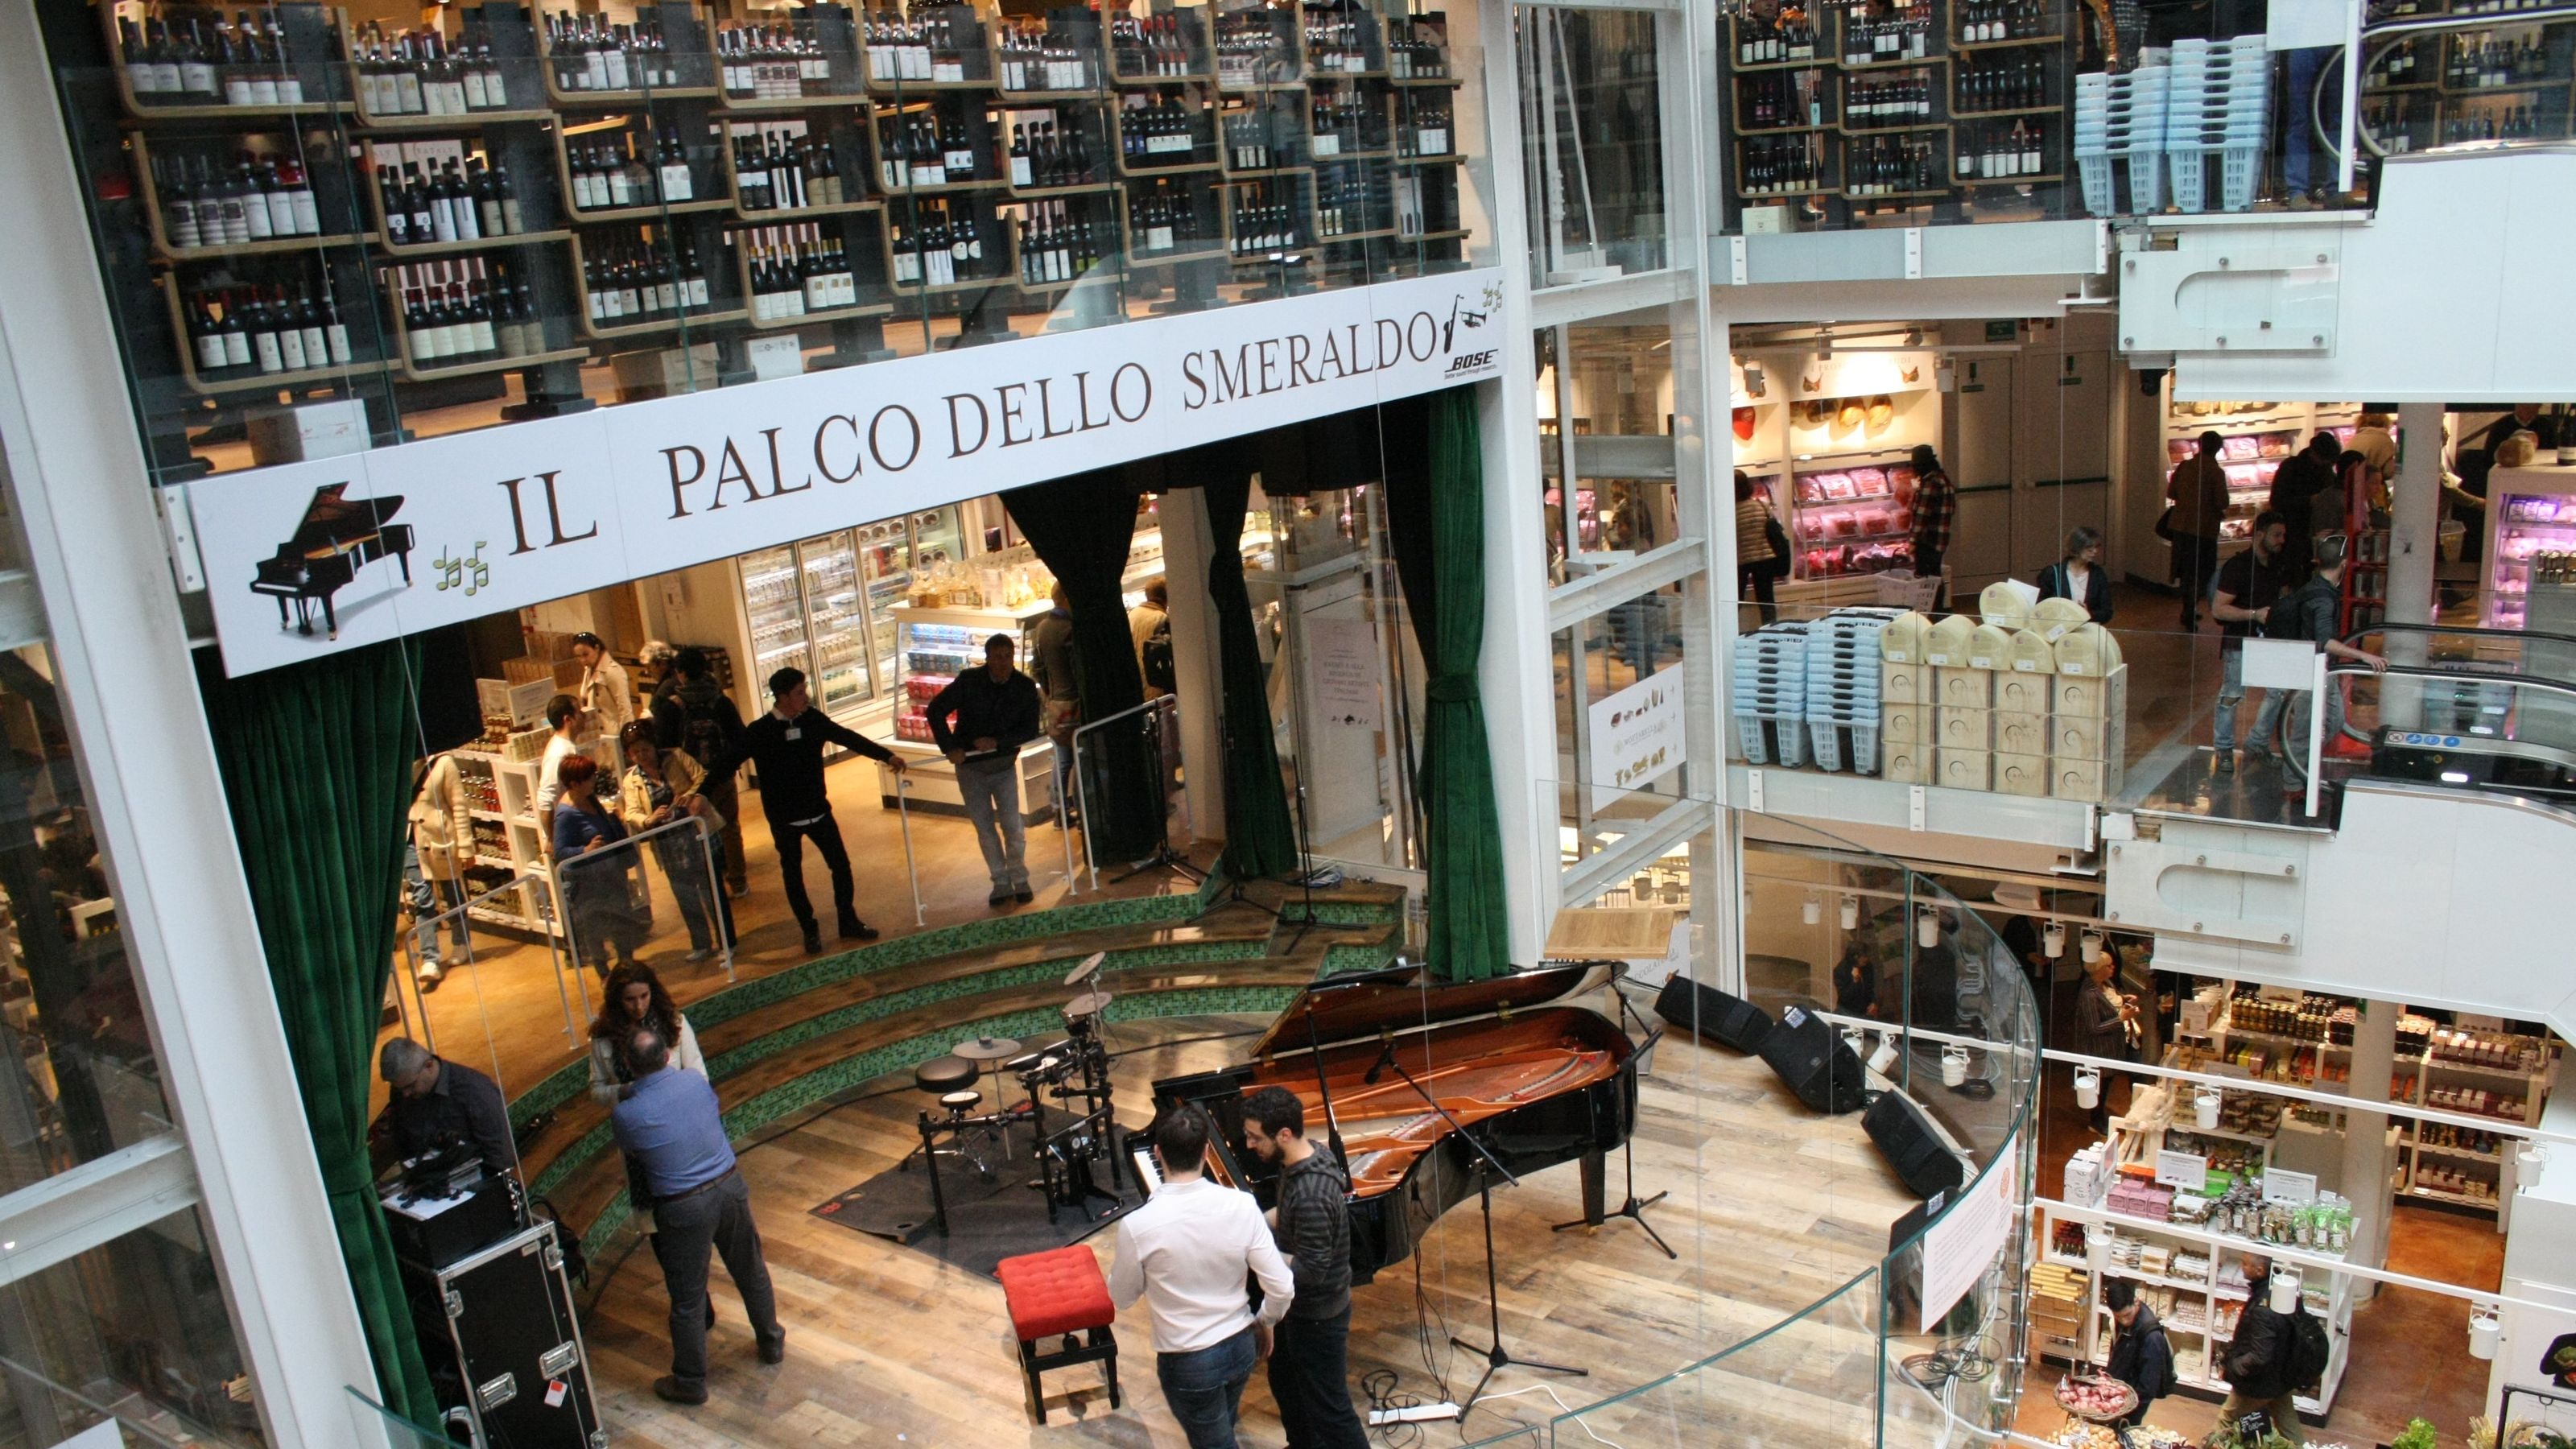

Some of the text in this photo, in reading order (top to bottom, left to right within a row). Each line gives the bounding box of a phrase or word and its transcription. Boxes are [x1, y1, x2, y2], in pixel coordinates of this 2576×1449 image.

[1444, 349, 1499, 373] BOSE
[497, 311, 1437, 555] IL PALCO DELLO SMERALDO
